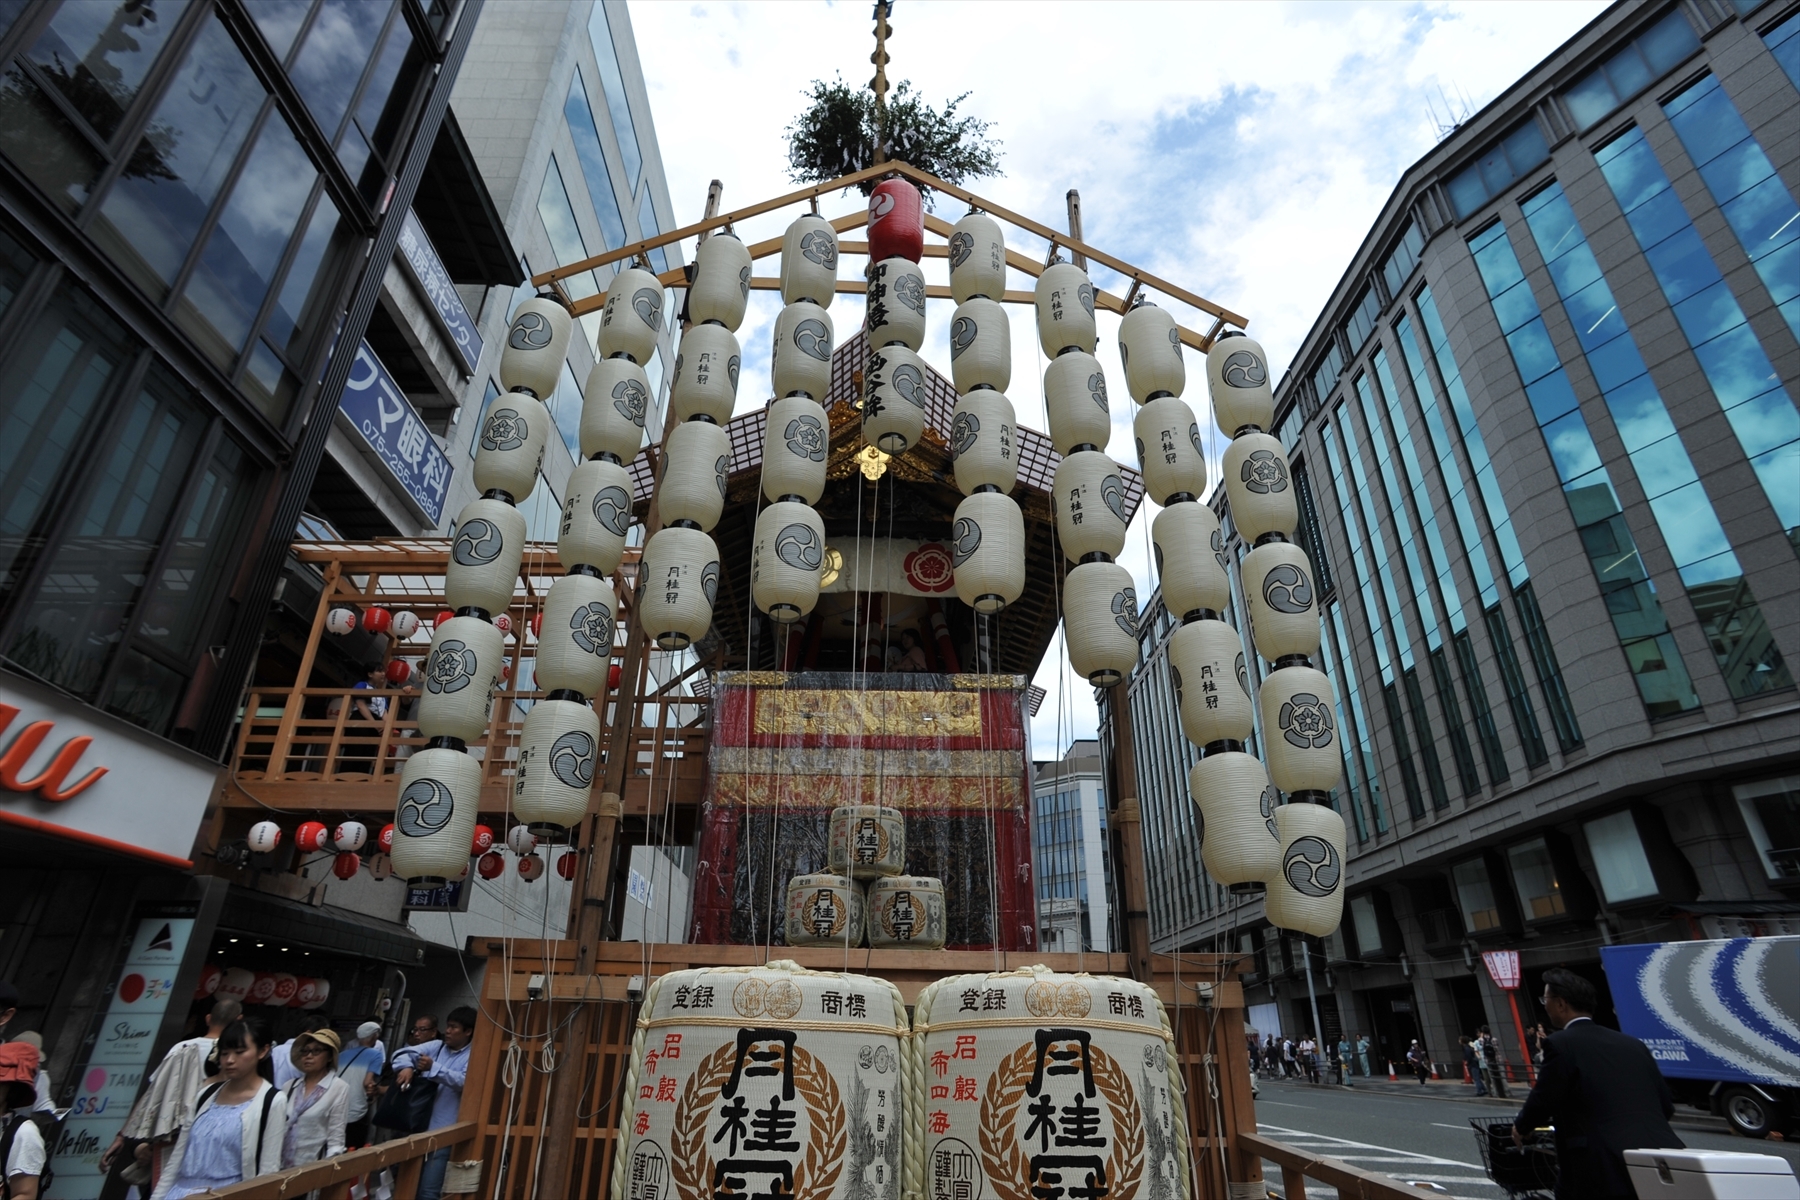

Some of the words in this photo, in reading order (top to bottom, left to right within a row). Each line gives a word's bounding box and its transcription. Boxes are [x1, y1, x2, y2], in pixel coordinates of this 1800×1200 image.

[401, 225, 476, 361] 糖尿病センター
[1051, 291, 1063, 321] 月桂冠
[697, 353, 711, 385] 月桂冠
[1000, 424, 1011, 460] 月桂冠
[1161, 430, 1177, 465] 月桂冠
[362, 419, 439, 520] 075-255-0880
[562, 498, 575, 536] 月桂冠
[1070, 488, 1083, 526] 月桂冠
[665, 566, 681, 605] 月桂冠
[1201, 665, 1219, 710] 月桂冠
[516, 750, 529, 796] 月桂冠
[857, 817, 878, 866] 月桂冠
[812, 888, 835, 938] 月桂冠
[891, 890, 914, 941] 月桂冠
[671, 984, 715, 1010] 登録
[820, 990, 867, 1019] 商標
[959, 988, 1007, 1013] 登録
[1107, 991, 1145, 1019] 商標
[1652, 1050, 1690, 1061] GAWA
[109, 1073, 141, 1087] TAM
[73, 1096, 109, 1115] SSJ
[713, 1028, 800, 1200] 月桂冠
[1024, 1028, 1109, 1200] 月桂冠
